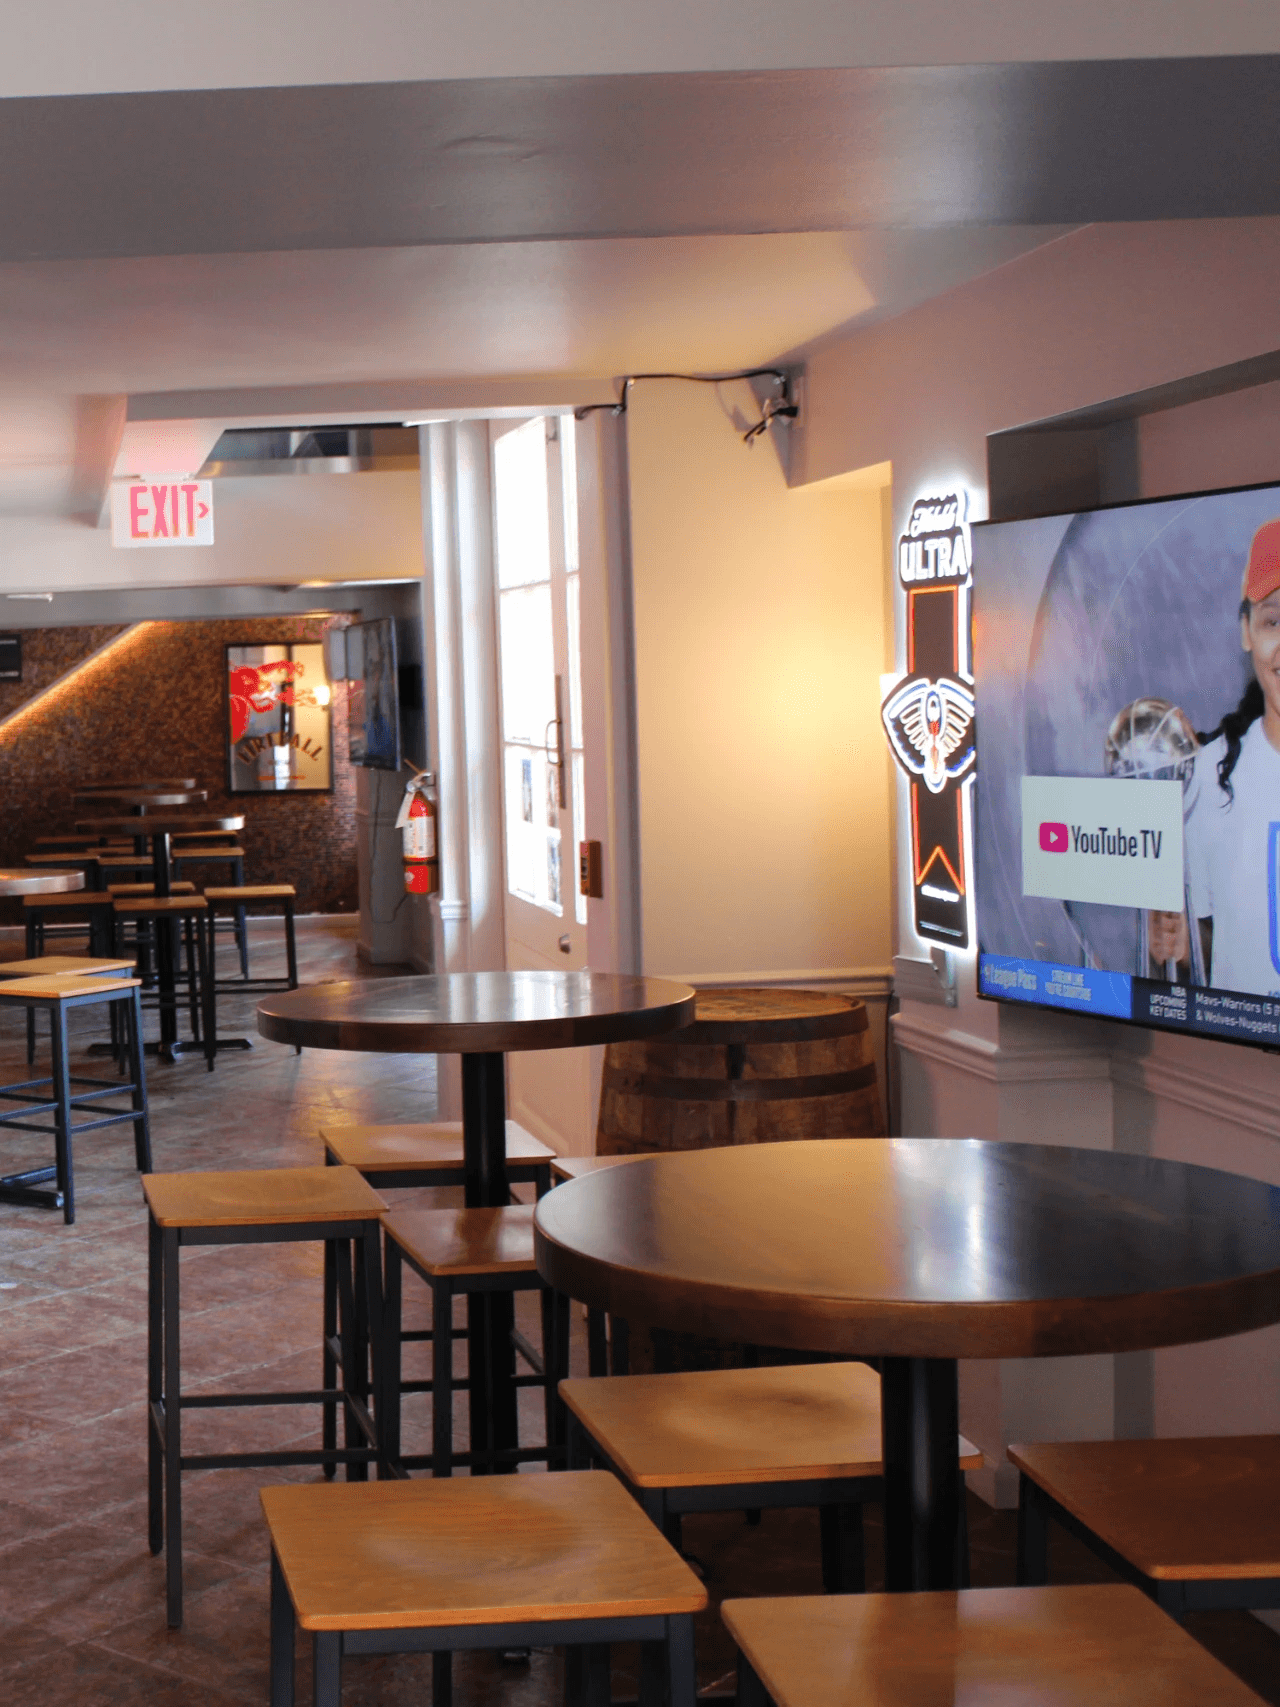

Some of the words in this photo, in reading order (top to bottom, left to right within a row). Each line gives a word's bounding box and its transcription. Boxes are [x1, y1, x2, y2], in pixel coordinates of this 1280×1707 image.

[129, 484, 199, 539] EXIT
[900, 534, 969, 582] ULTRA
[1071, 825, 1138, 858] YouTube
[1140, 830, 1163, 859] TV
